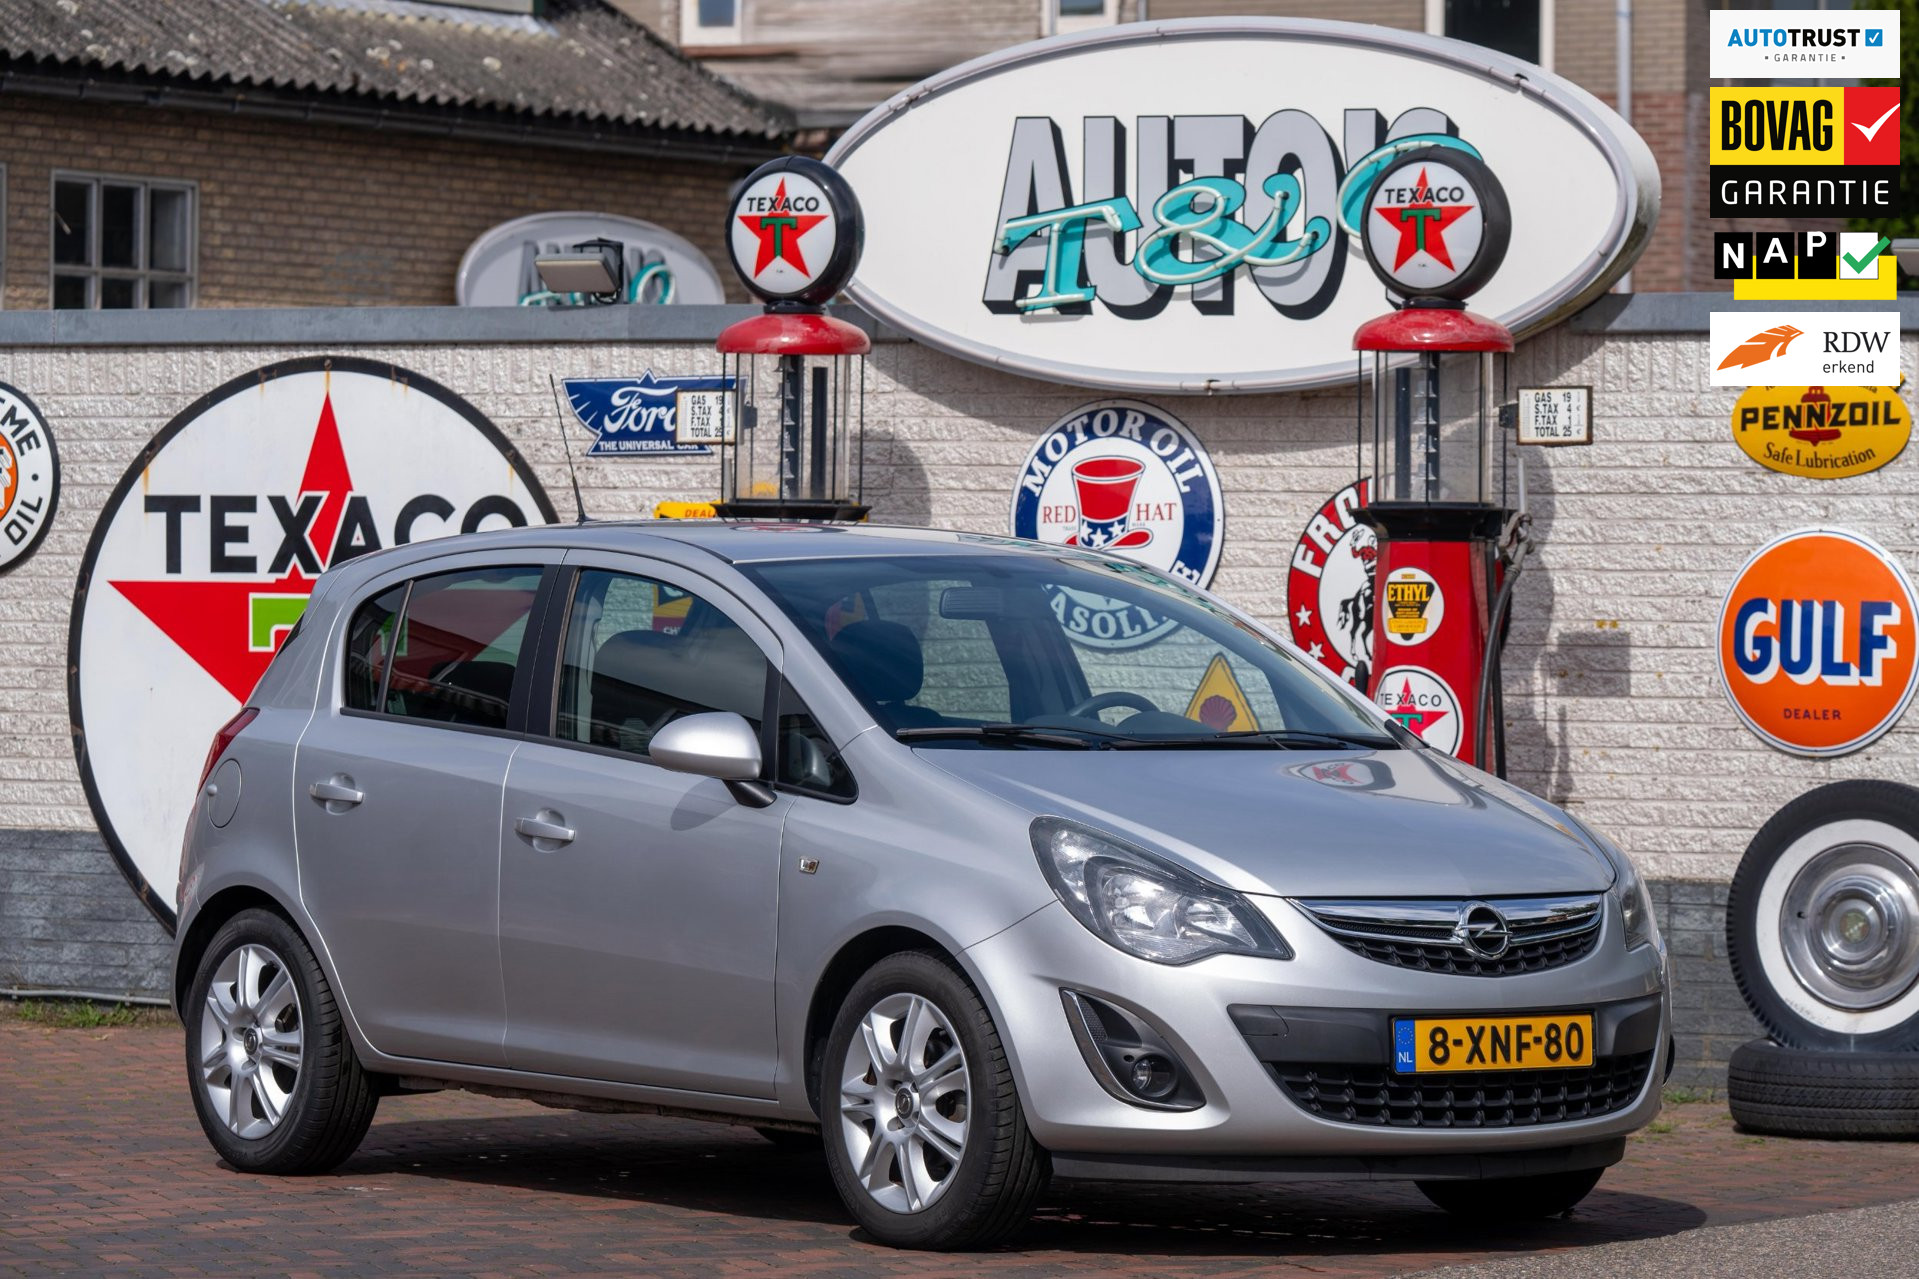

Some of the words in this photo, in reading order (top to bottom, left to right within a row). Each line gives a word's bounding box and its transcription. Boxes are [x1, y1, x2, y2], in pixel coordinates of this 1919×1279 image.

[747, 197, 819, 212] TEXACO
[1385, 187, 1464, 204] TEXACO
[760, 216, 797, 257] T
[1400, 208, 1442, 251] T
[691, 395, 706, 405] GAS
[1535, 392, 1551, 403] GAS
[1563, 392, 1571, 403] 19
[1535, 403, 1558, 414] S.TAX
[1741, 401, 1902, 432] PENNZOIL
[0, 400, 41, 456] ME
[691, 427, 711, 437] TOTAL
[1535, 427, 1559, 437] TOTAL
[599, 441, 618, 451] THE
[619, 440, 674, 450] UNIVERSAL
[1023, 409, 1146, 497] MOTOR
[1150, 428, 1203, 493] OIL
[1763, 442, 1793, 466] Safe
[1796, 448, 1876, 469] Lubrication
[4, 496, 43, 546] OIL
[1043, 505, 1076, 524] RED
[1136, 503, 1177, 521] HAT
[1388, 583, 1430, 602] ETHYL
[1733, 597, 1901, 687] GULF
[1783, 708, 1841, 720] DEALER
[1398, 1051, 1413, 1063] NL
[1428, 1022, 1584, 1066] 8-XNF-80
